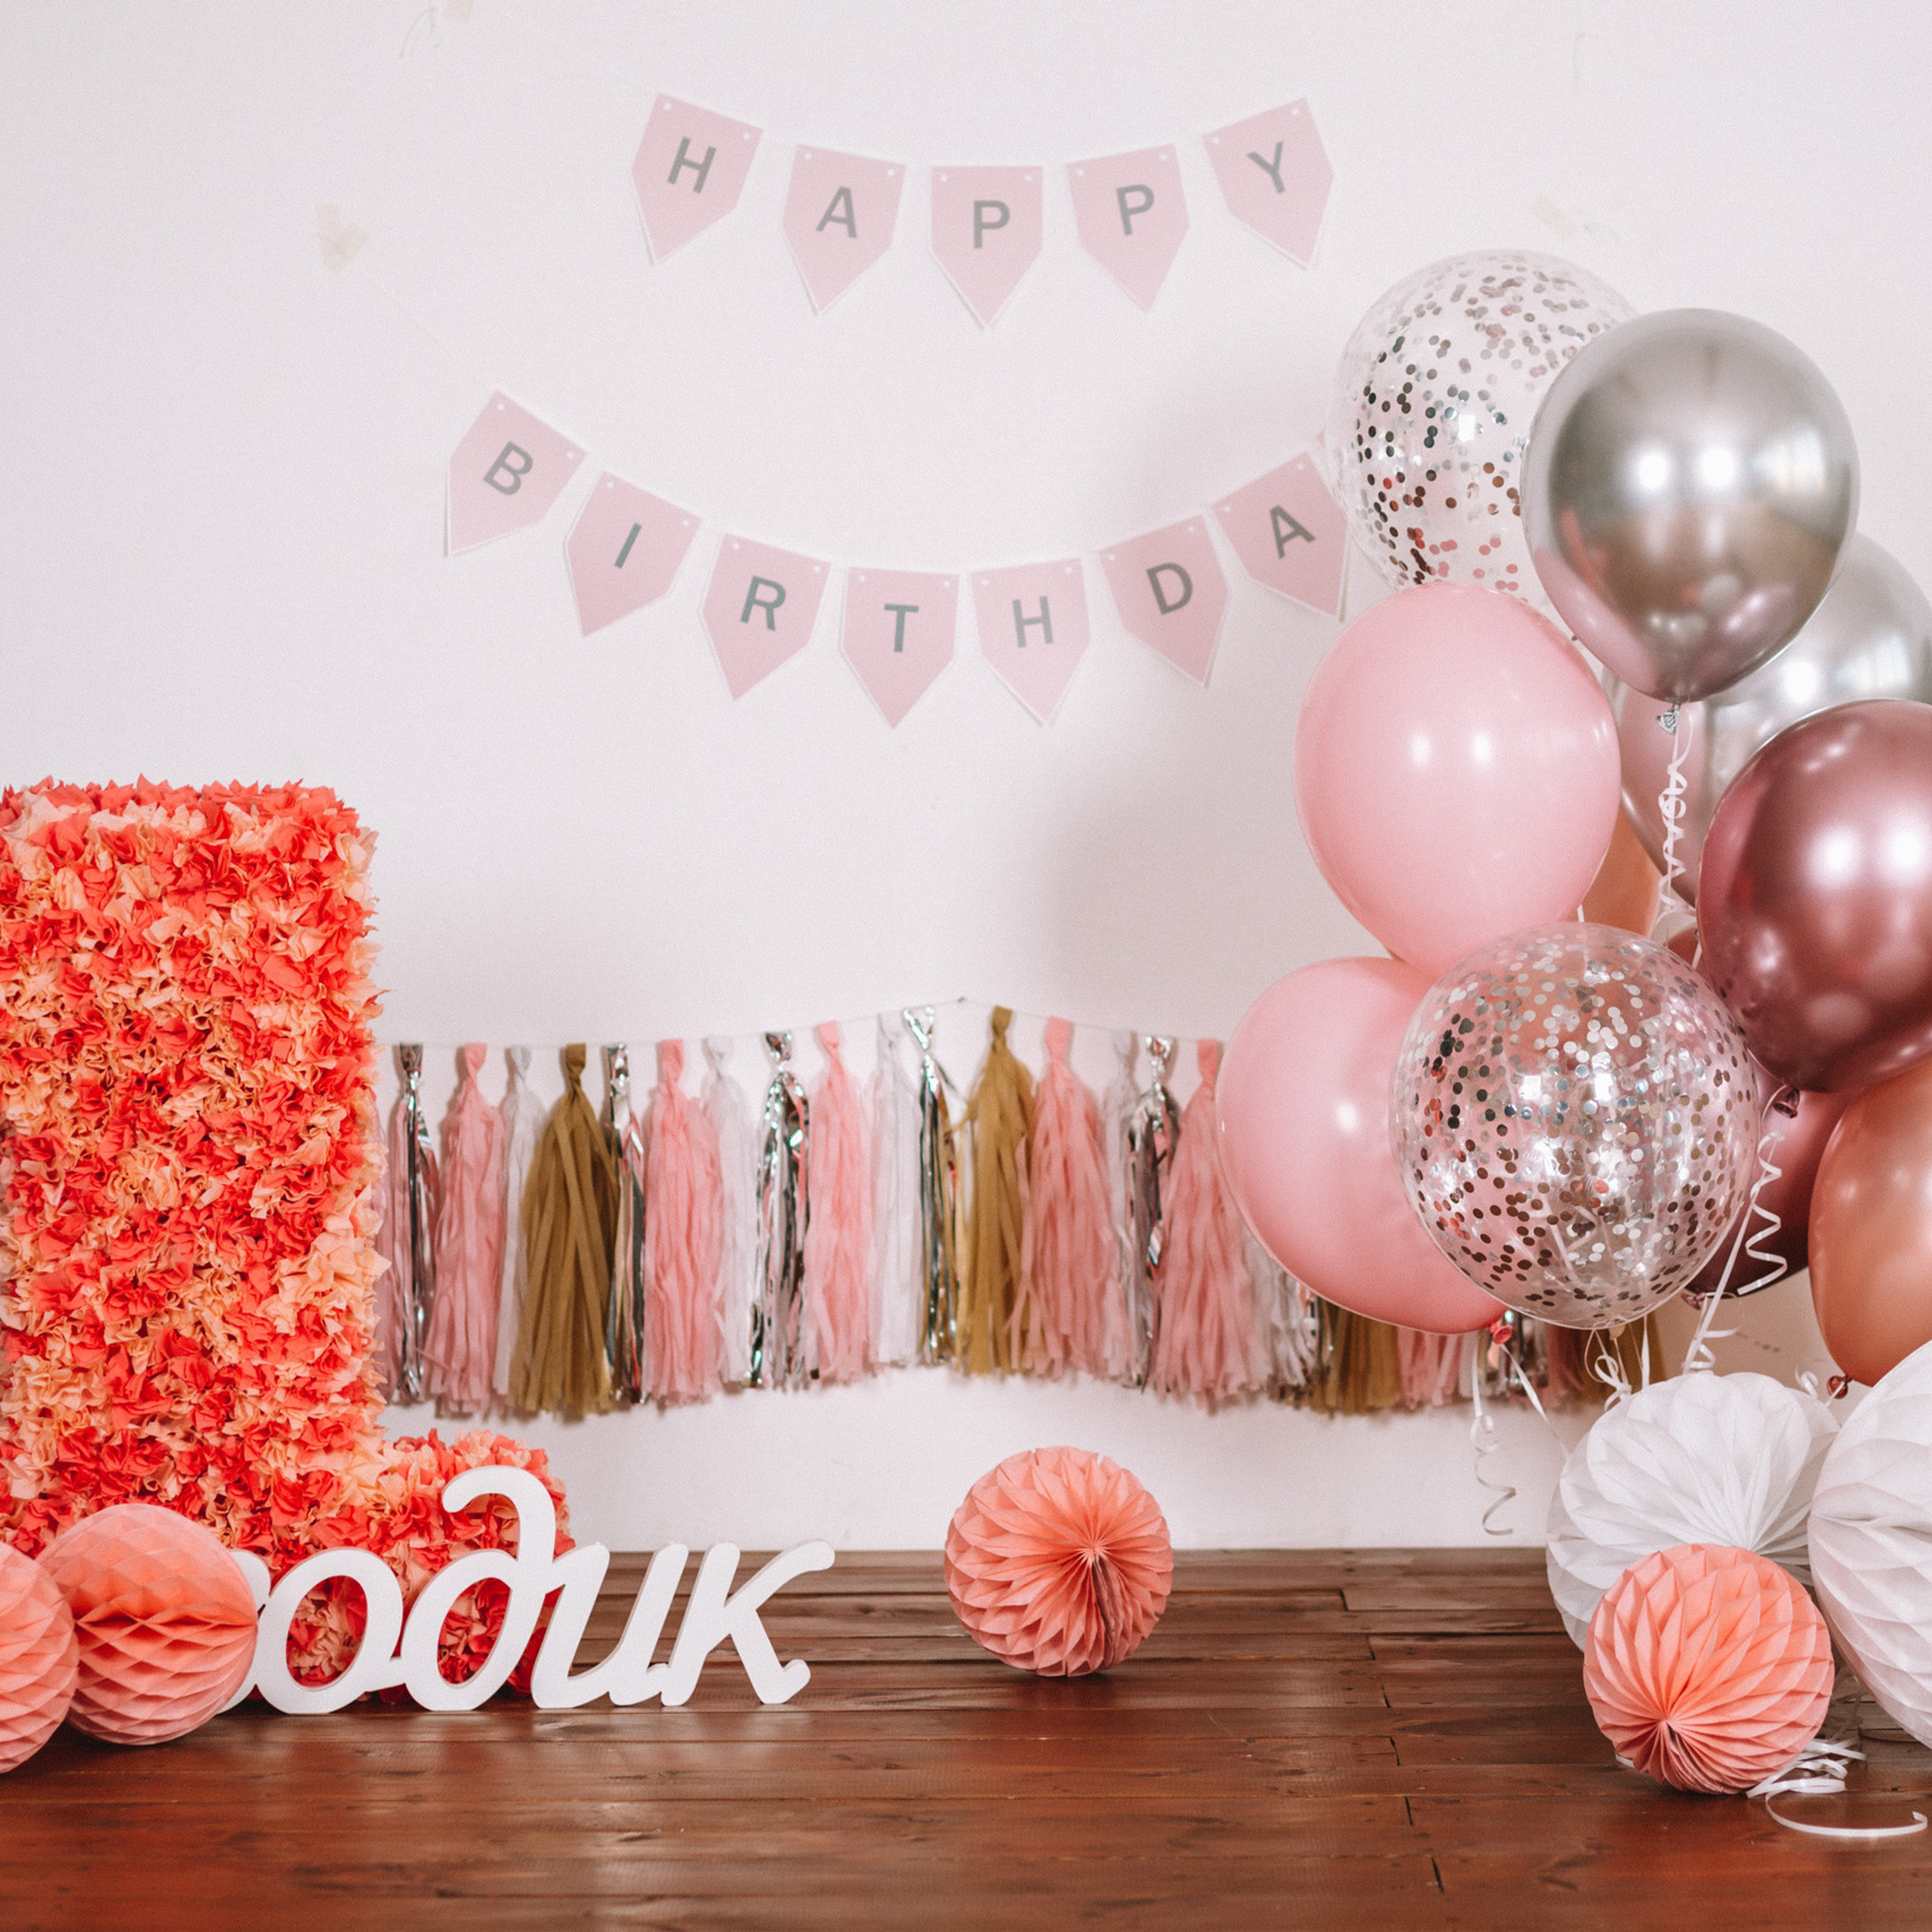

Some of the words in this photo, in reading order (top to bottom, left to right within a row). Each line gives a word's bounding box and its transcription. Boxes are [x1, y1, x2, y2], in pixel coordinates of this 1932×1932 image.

[668, 137, 1290, 249] HAPPY
[483, 441, 1315, 654] BIRTHDA
[217, 1466, 835, 1714] одик
